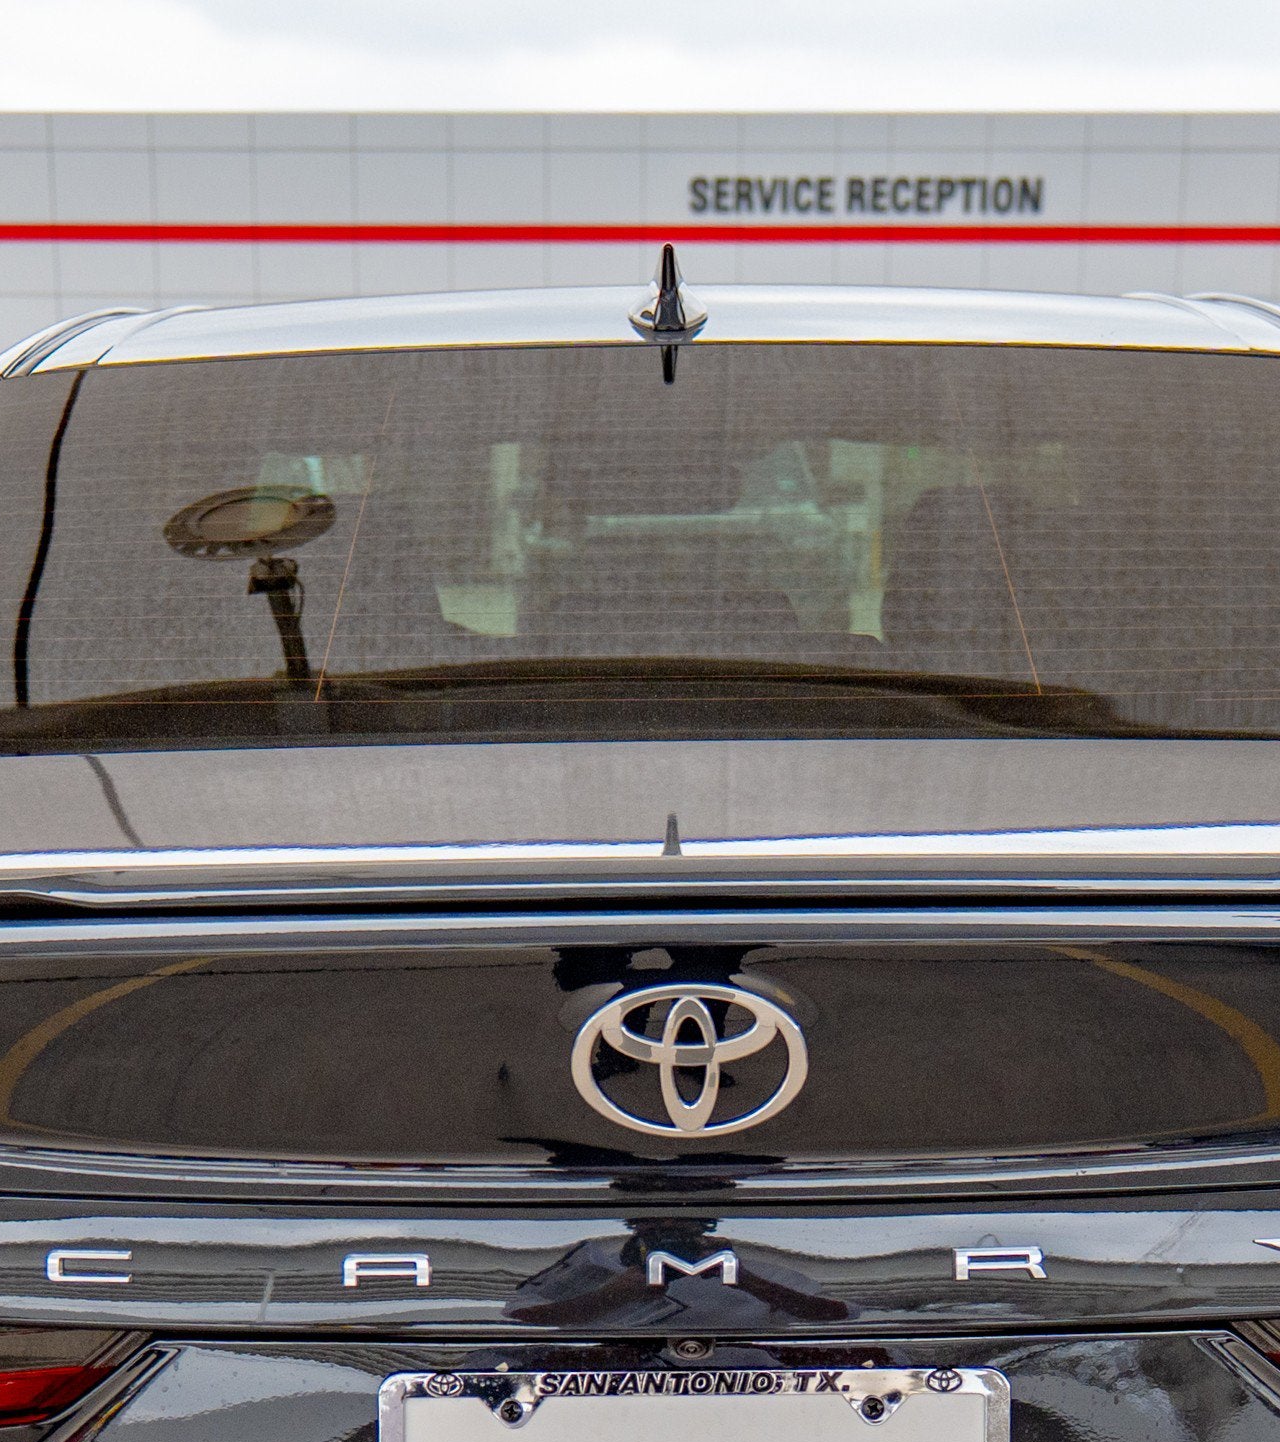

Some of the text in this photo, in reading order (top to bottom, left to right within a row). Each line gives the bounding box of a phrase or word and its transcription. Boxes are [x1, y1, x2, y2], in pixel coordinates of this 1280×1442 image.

[688, 176, 1045, 214] SERVICE RECEPTION
[539, 1372, 609, 1395] SAN
[795, 1371, 851, 1392] TX.
